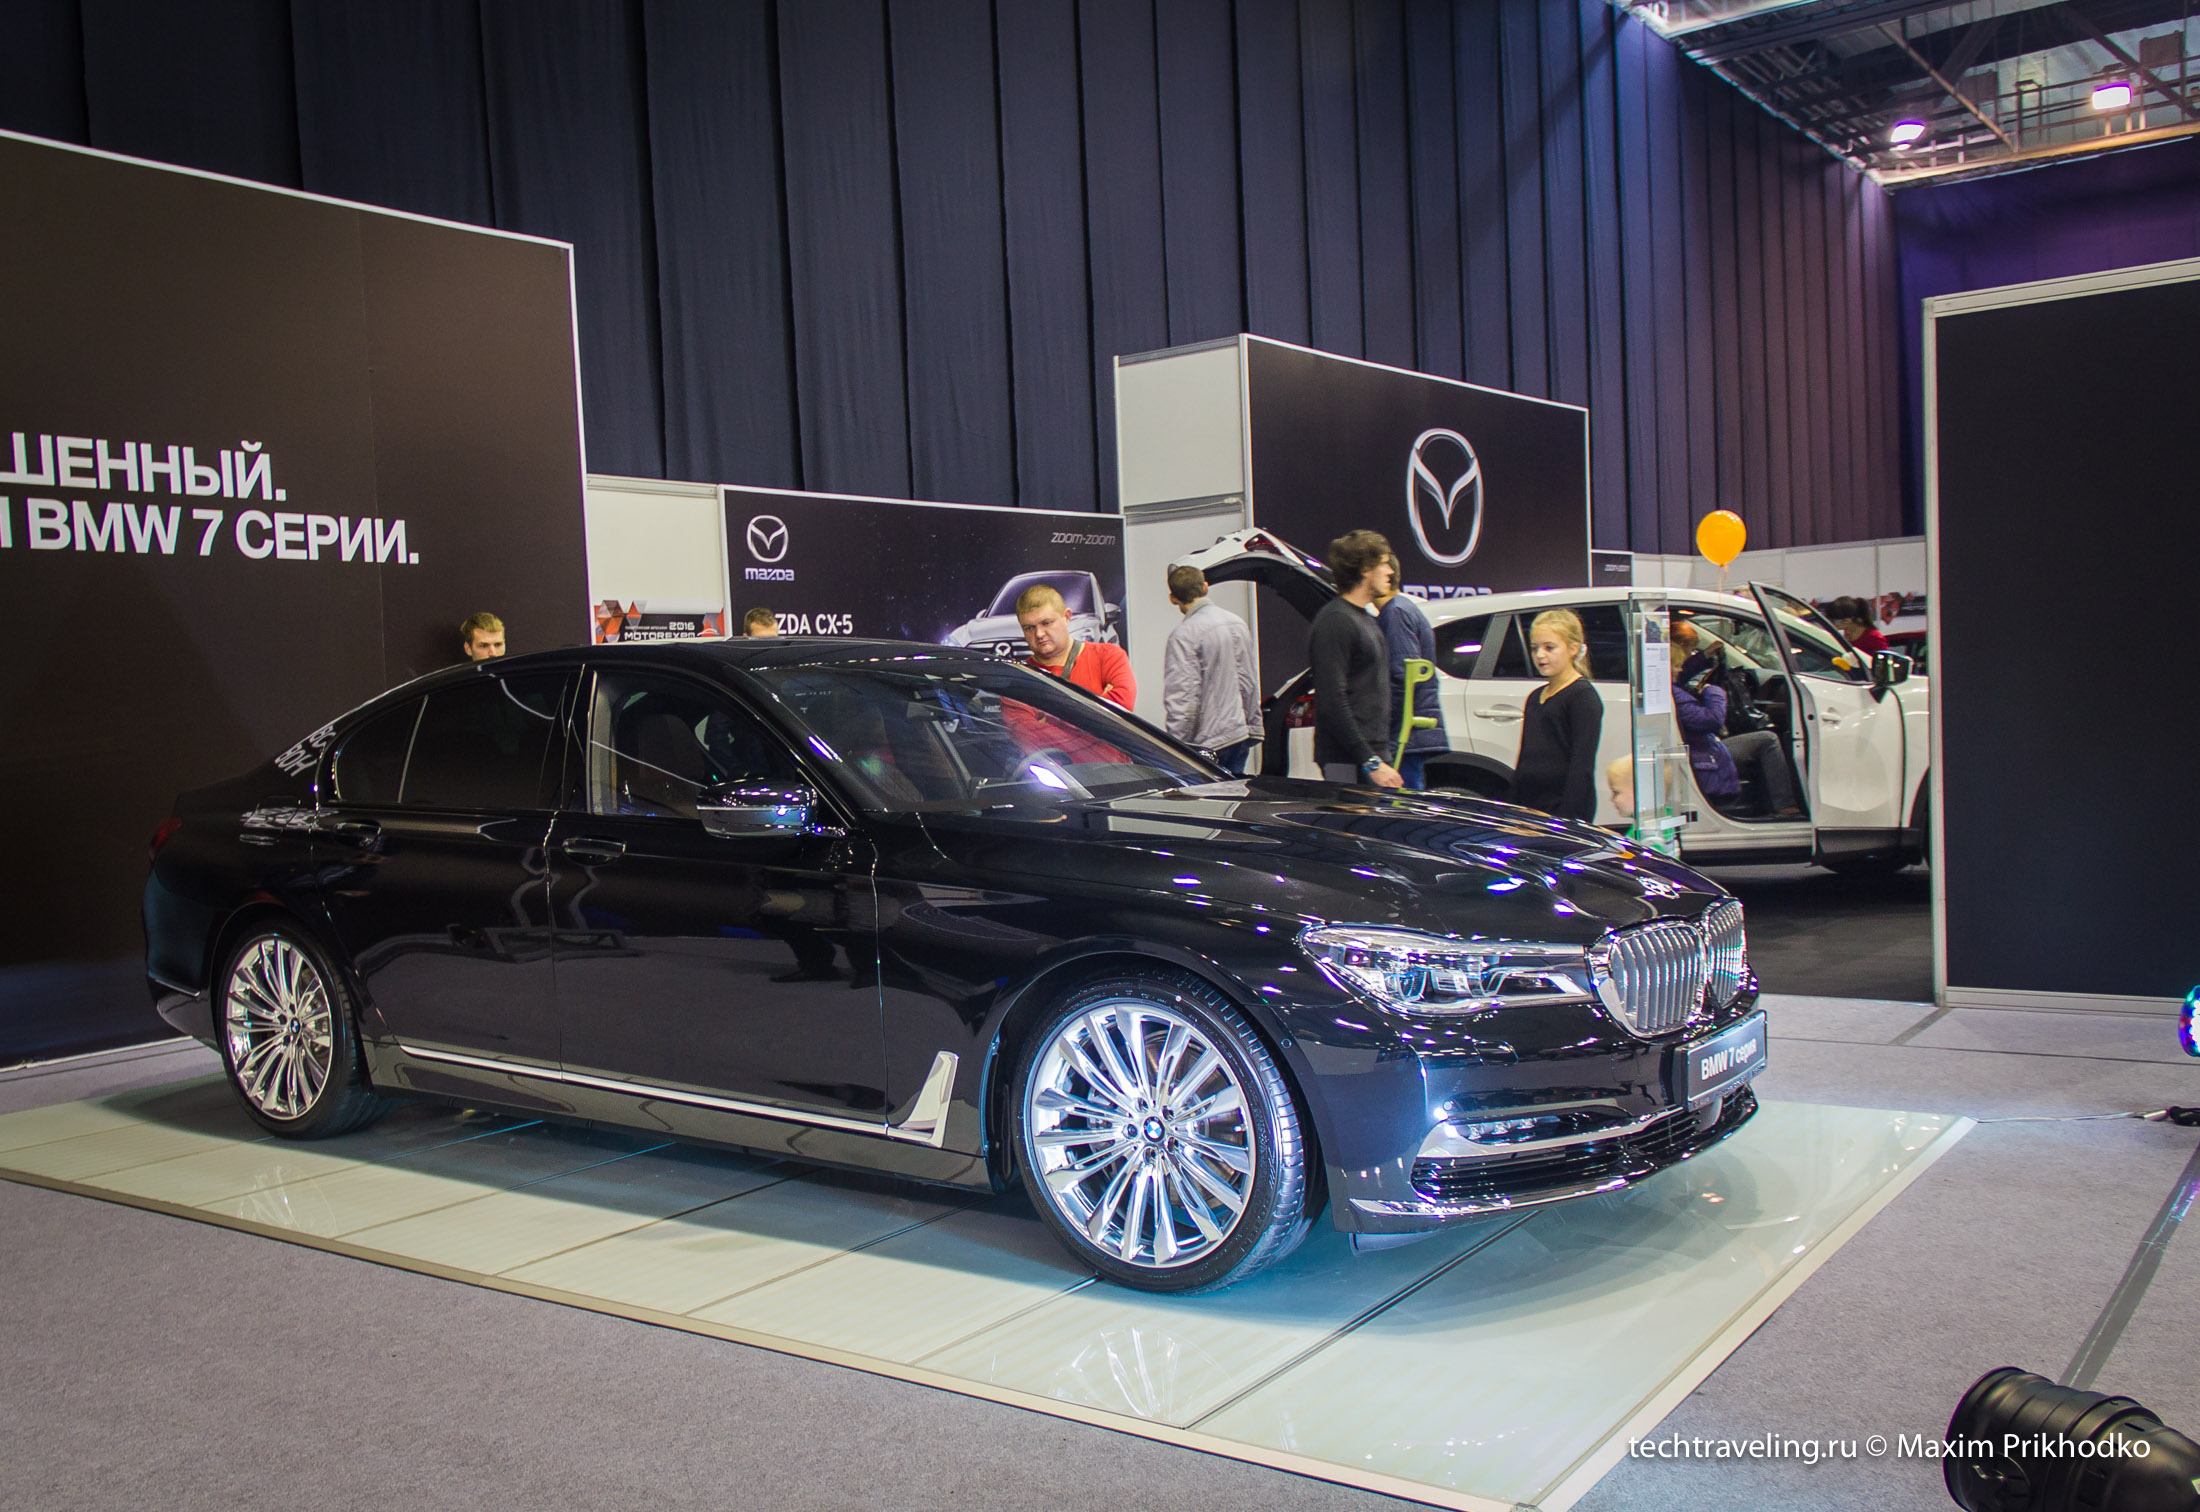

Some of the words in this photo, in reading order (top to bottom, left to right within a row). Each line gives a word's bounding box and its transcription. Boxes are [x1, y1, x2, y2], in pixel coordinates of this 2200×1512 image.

[27, 498, 182, 554] BMW
[192, 508, 224, 556] 7
[236, 509, 420, 564] СЕРИИ.
[744, 567, 795, 581] mazda
[668, 621, 695, 631] 2016
[774, 613, 812, 635] ZDA
[815, 613, 853, 635] CX-5
[1701, 1049, 1728, 1081] BMW
[1728, 1046, 1735, 1068] 7
